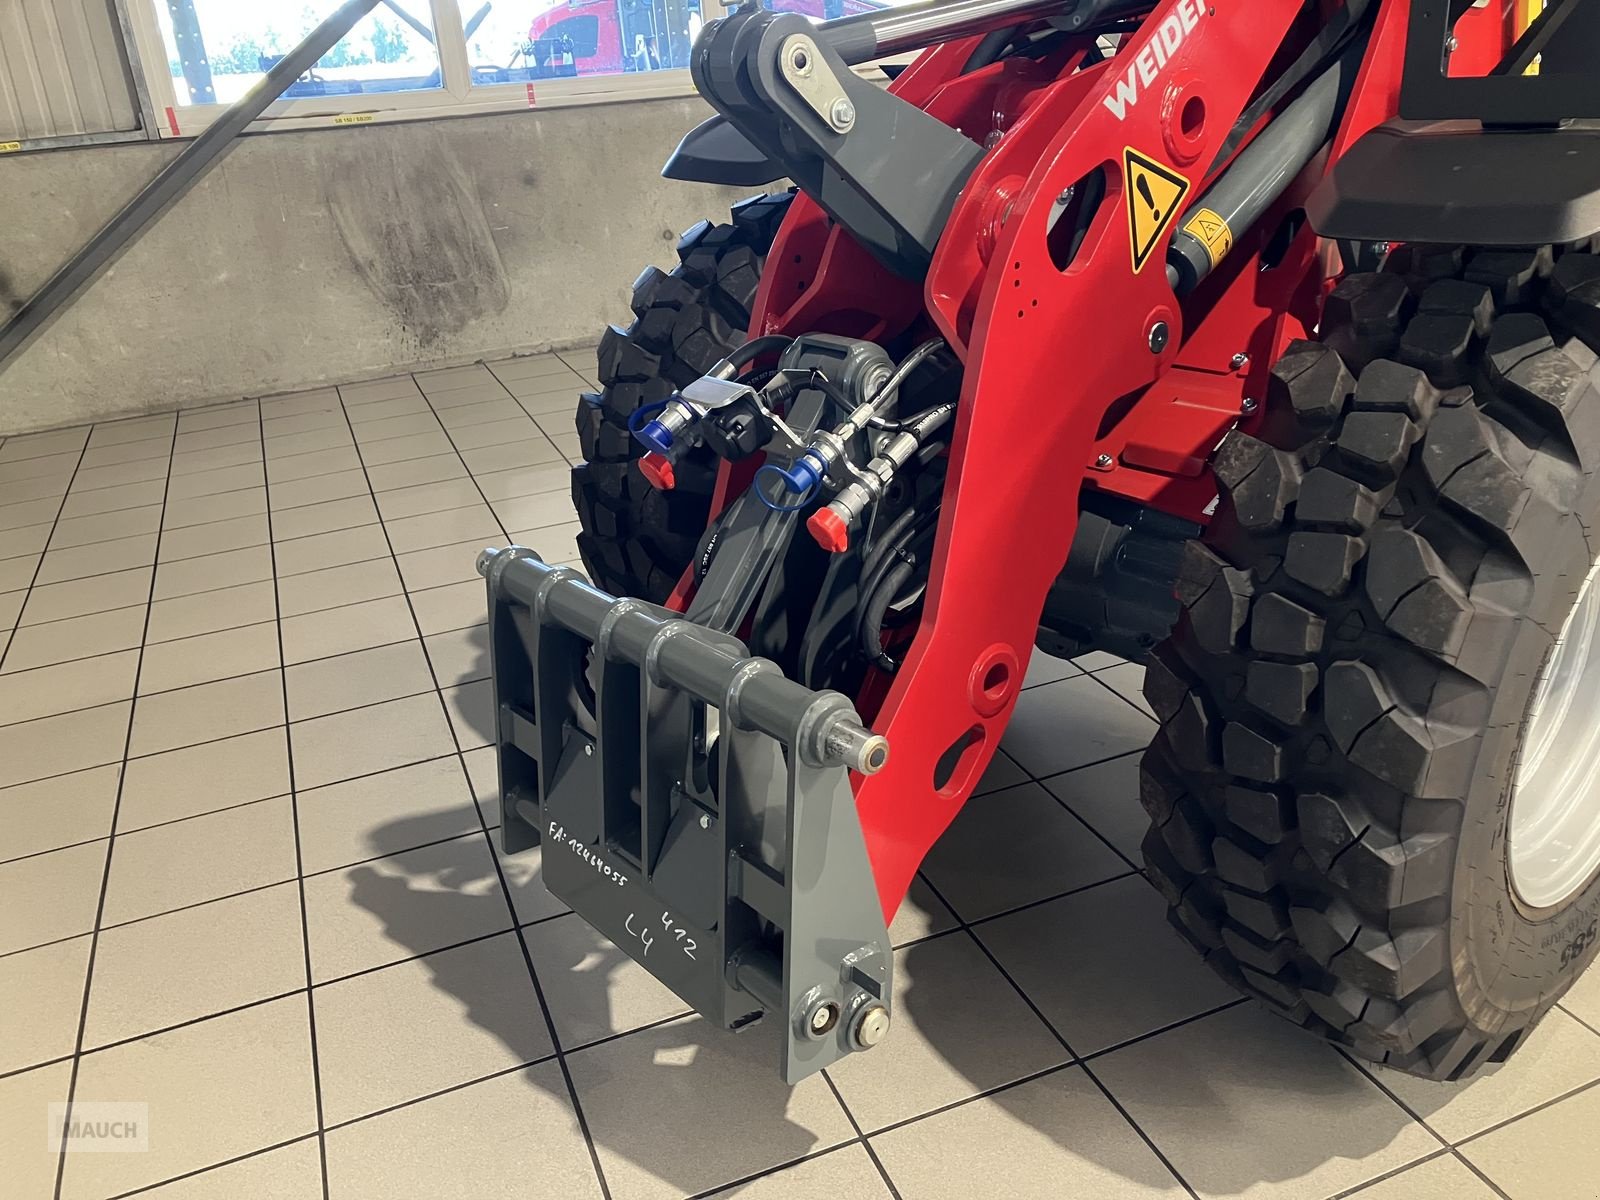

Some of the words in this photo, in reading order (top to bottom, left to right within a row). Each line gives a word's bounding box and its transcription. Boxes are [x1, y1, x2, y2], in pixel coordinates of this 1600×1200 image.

[549, 821, 567, 842] FA:
[568, 838, 629, 887] 12464055
[624, 912, 654, 957] L4
[661, 911, 697, 961] 412
